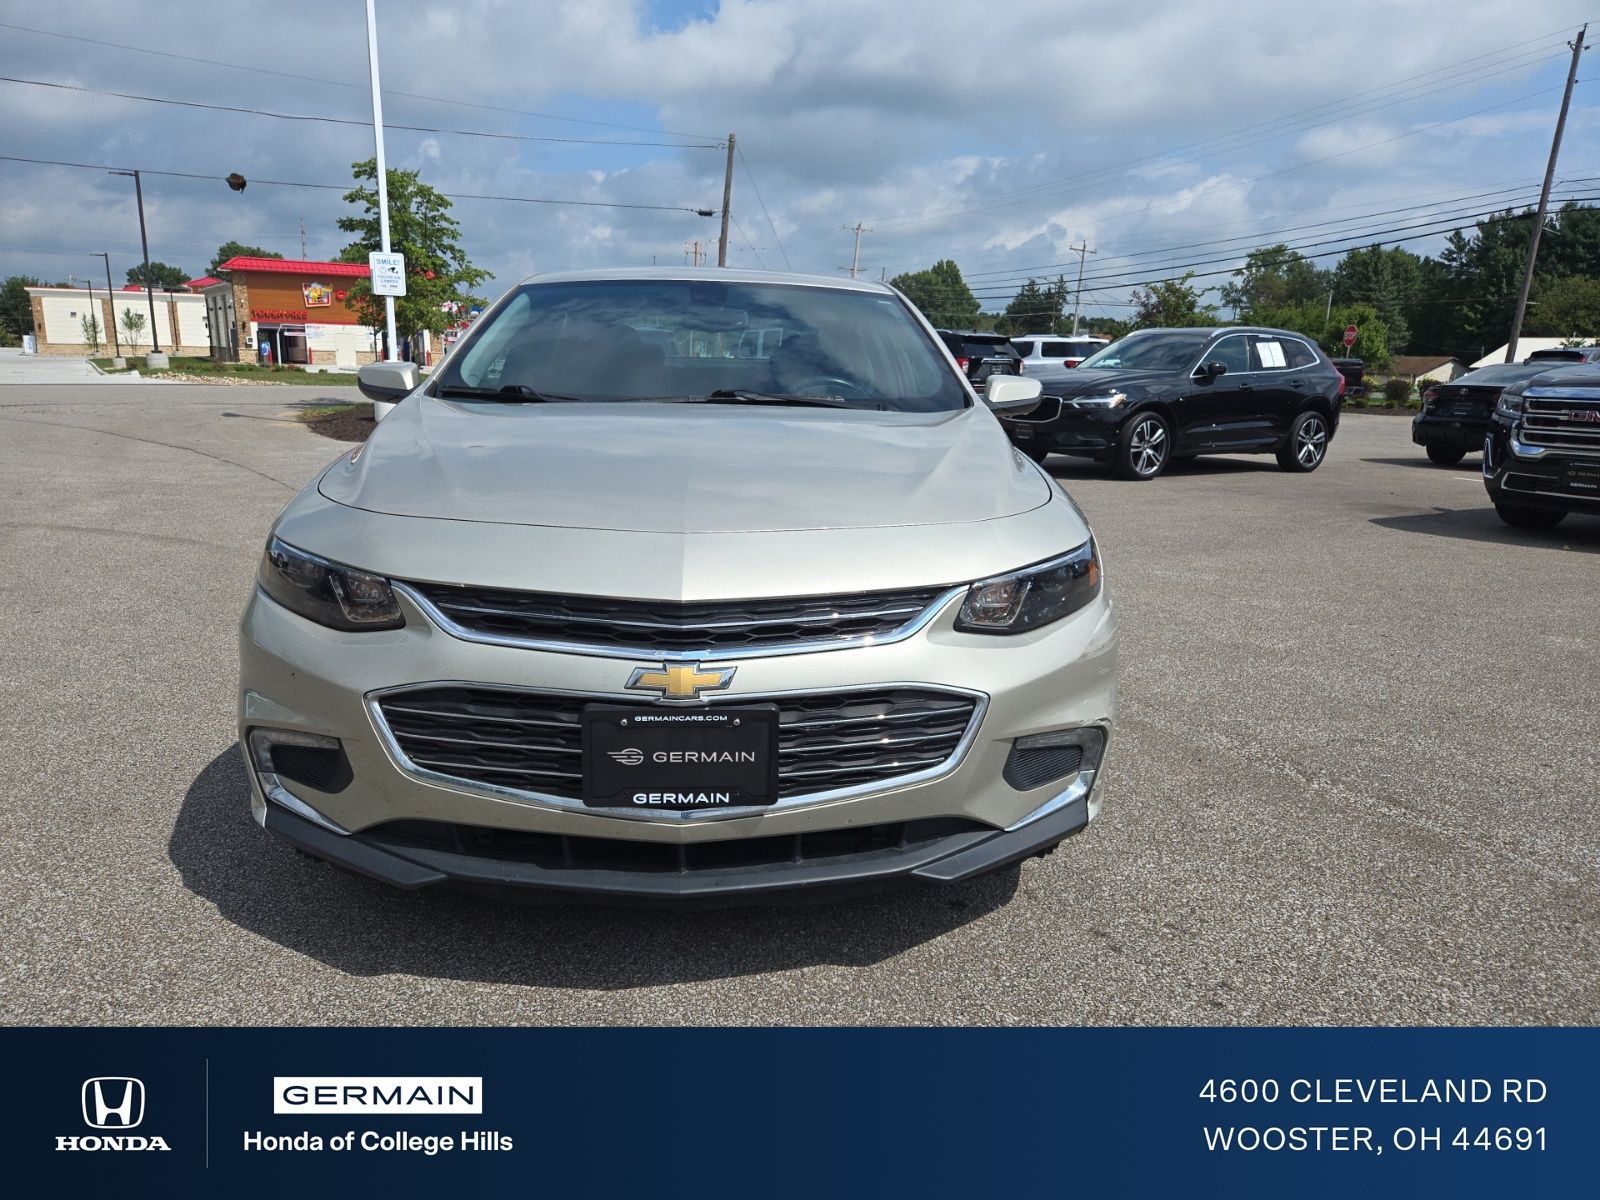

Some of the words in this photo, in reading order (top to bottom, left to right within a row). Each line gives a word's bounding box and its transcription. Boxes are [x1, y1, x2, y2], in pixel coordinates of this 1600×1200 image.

[376, 258, 400, 266] SMILE!
[1344, 331, 1356, 340] STOP
[634, 714, 728, 722] GERMAINCARS.COM
[652, 751, 756, 763] GERMAIN
[632, 792, 730, 804] GERMAIN
